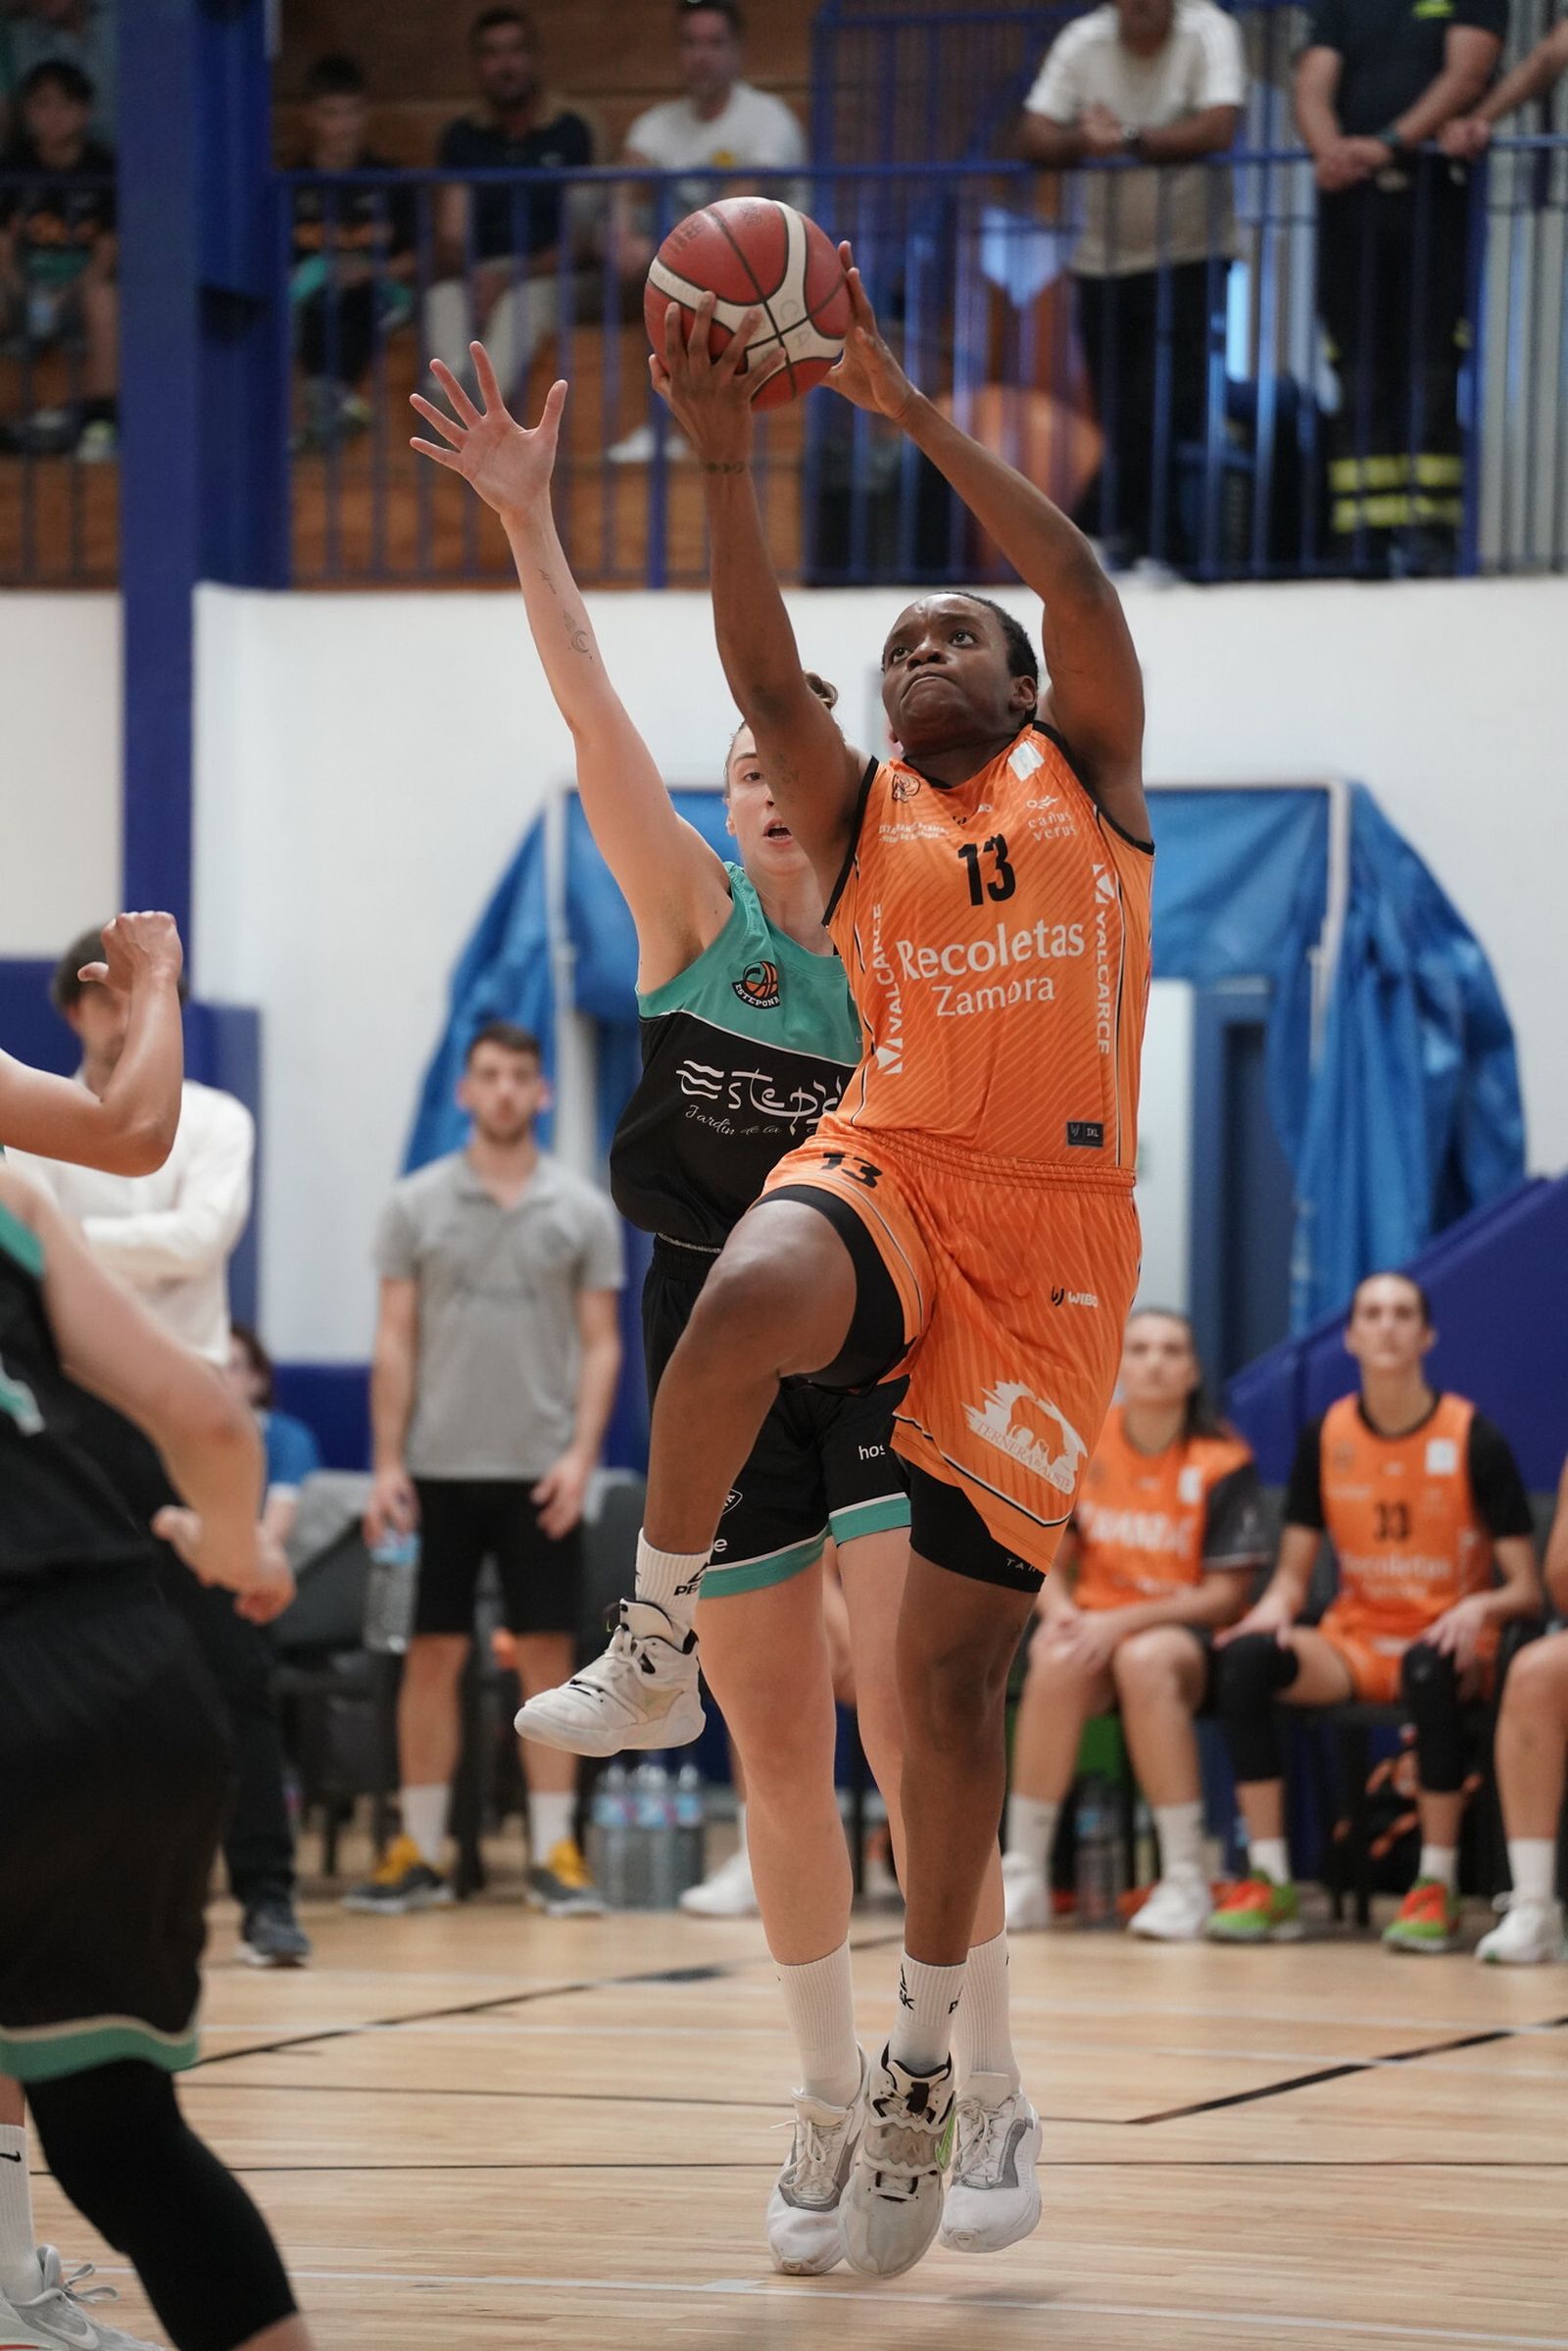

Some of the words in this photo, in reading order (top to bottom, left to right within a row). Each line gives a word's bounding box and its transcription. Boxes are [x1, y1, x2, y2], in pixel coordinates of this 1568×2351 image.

[957, 833, 1015, 906] 13
[896, 918, 1086, 982] Recoletas
[1096, 910, 1110, 1054] VALCARCE
[735, 984, 780, 1007] ESTEPONA
[931, 976, 1055, 1017] Zamora
